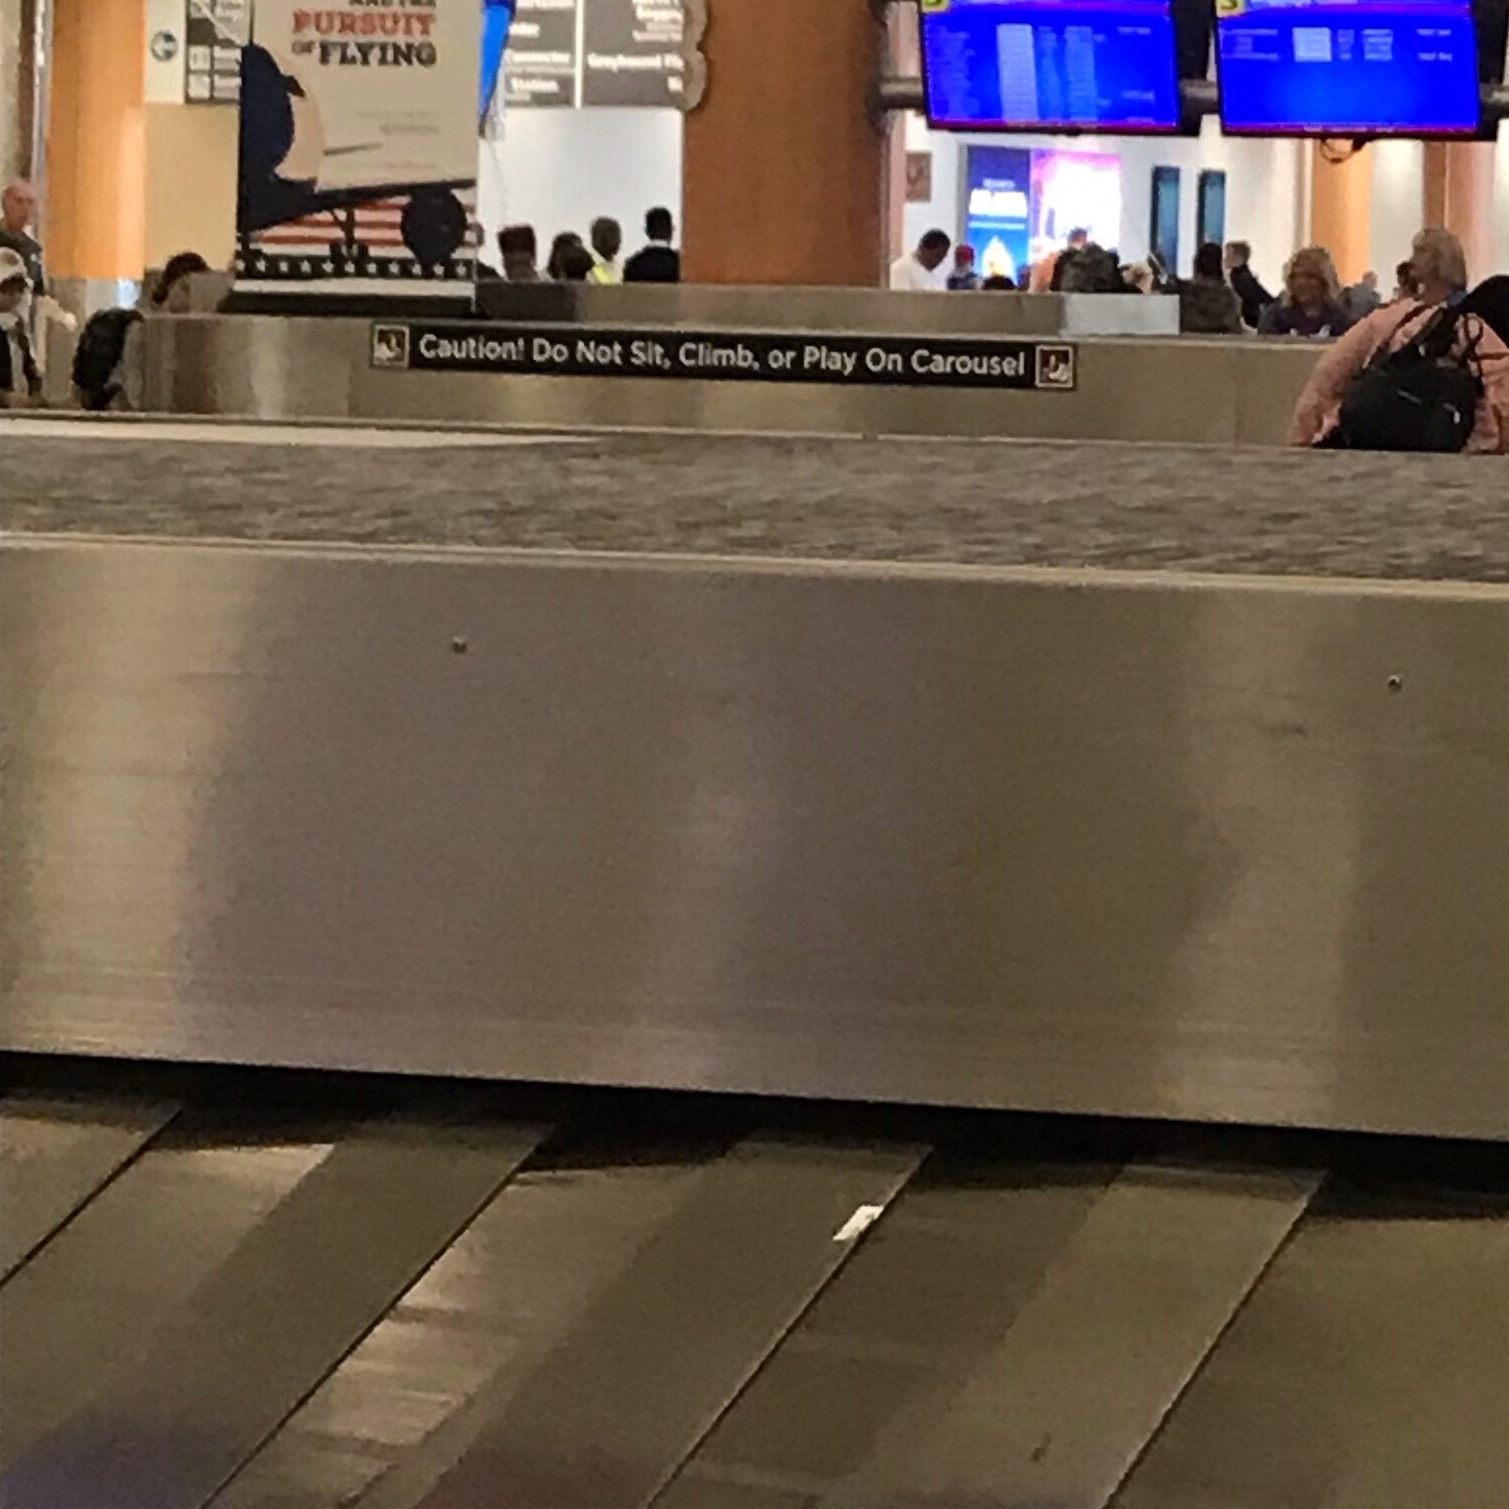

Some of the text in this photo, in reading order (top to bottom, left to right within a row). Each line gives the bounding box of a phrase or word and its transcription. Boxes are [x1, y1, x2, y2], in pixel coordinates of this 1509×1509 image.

[293, 9, 437, 36] PURSUIT
[319, 42, 438, 68] FLYING
[419, 333, 1025, 377] Caution! Do Not Sit, Climb, or Play On Carousel
